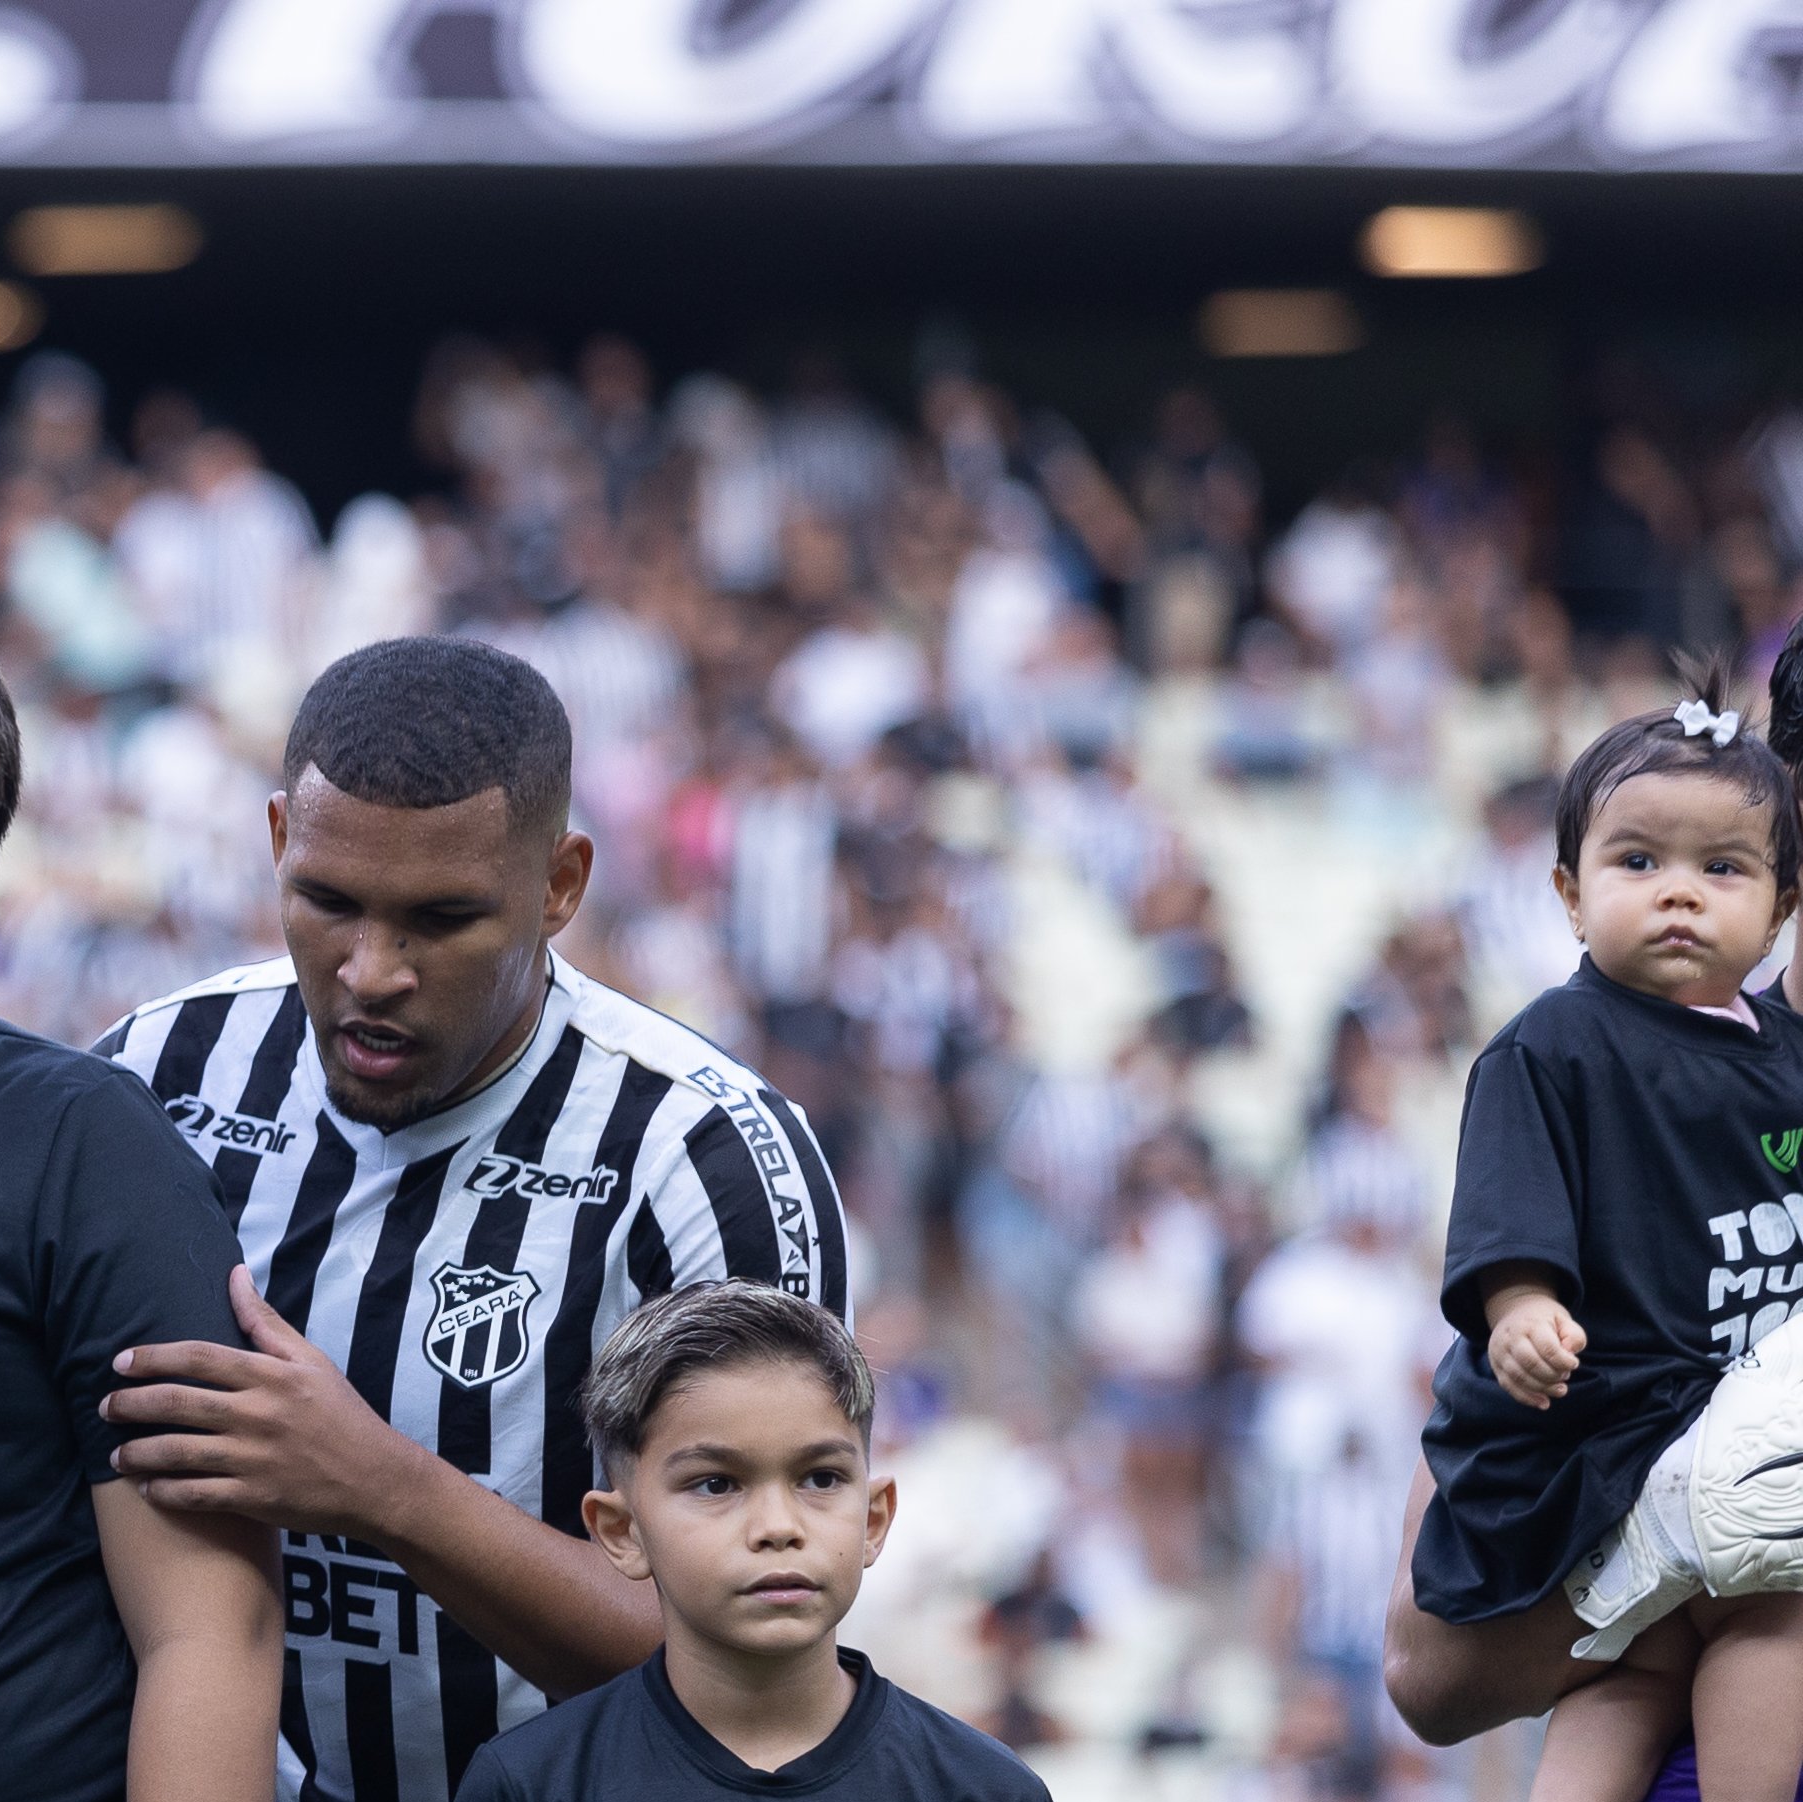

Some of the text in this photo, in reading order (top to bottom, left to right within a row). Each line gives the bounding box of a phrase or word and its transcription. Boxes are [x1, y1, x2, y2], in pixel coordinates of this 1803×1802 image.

[212, 1112, 296, 1154] zenir
[438, 1282, 524, 1335] CEARÁ
[282, 1553, 420, 1656] BET
